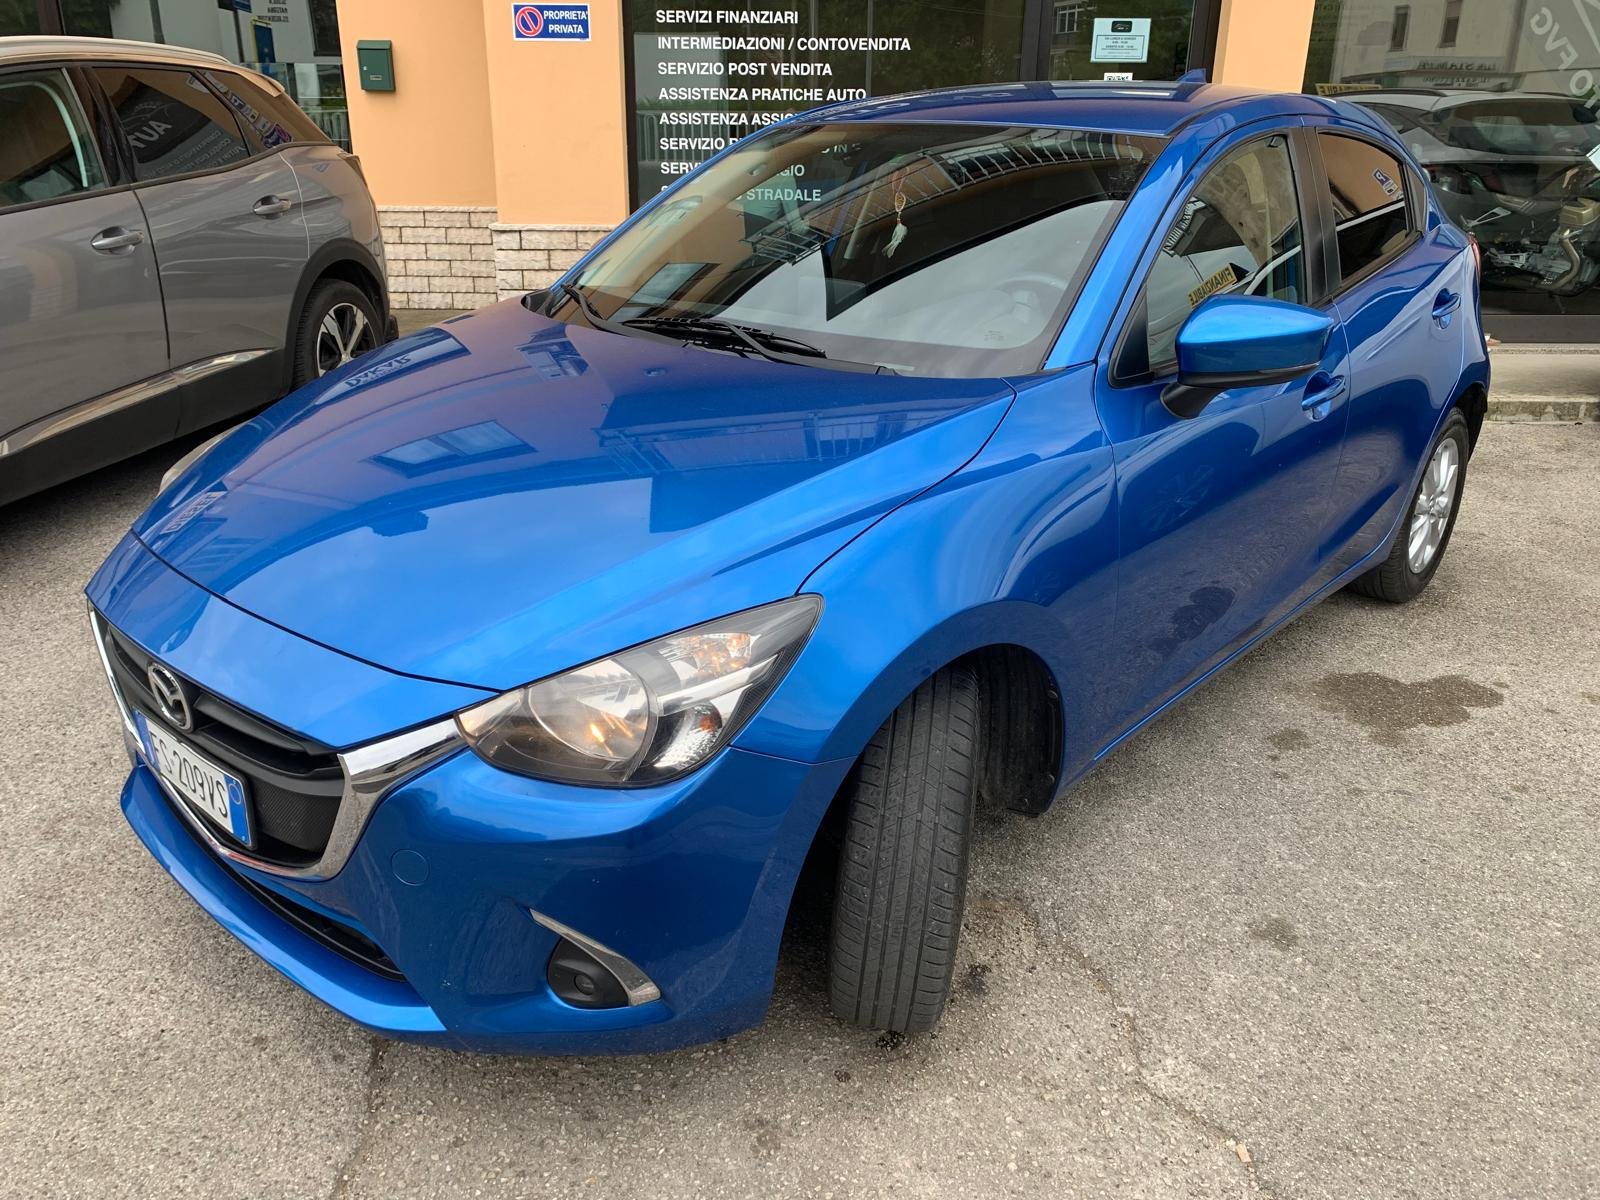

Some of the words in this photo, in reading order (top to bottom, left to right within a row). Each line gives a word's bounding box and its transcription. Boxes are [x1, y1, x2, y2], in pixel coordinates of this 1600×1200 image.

[543, 10, 588, 20] PROPRIETA'
[656, 10, 712, 23] SERVIZI
[716, 10, 798, 24] FINANZIARI
[549, 25, 584, 34] PRIVATA
[657, 36, 785, 50] INTERMEDIAZIONI
[797, 37, 911, 51] CONTOVENDITA
[657, 62, 724, 75] SERVIZIO
[728, 62, 767, 75] POST
[771, 63, 833, 76] VENDITA
[658, 87, 748, 100] ASSISTENZA
[752, 88, 823, 101] PRATICHE
[826, 88, 866, 101] AUTO
[659, 112, 748, 125] ASSISTENZA
[659, 137, 725, 150] SERVIZIO
[746, 188, 821, 201] STRADALE
